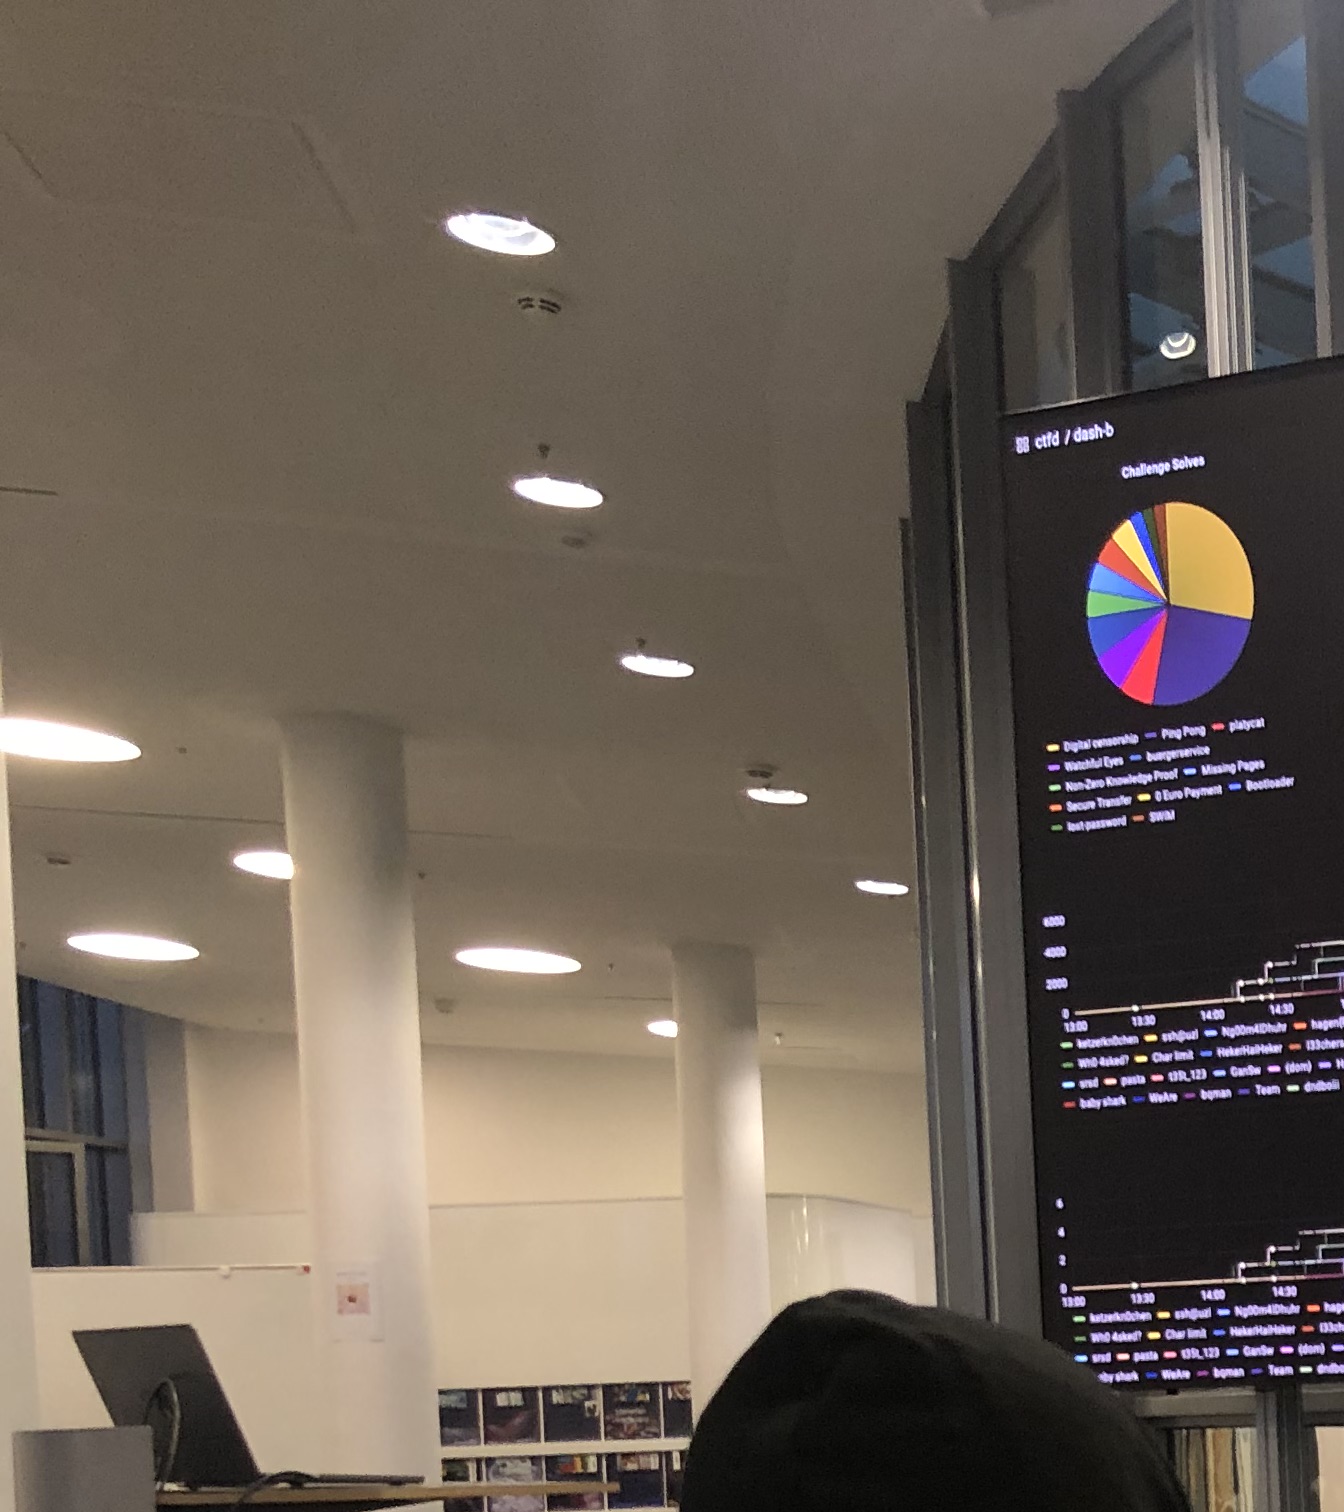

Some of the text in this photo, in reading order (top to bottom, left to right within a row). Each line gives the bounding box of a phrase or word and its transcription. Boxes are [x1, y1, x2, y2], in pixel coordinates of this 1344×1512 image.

[1035, 430, 1059, 449] ctfd
[1073, 421, 1114, 442] dash-b
[1121, 456, 1205, 479] Challenge Solves
